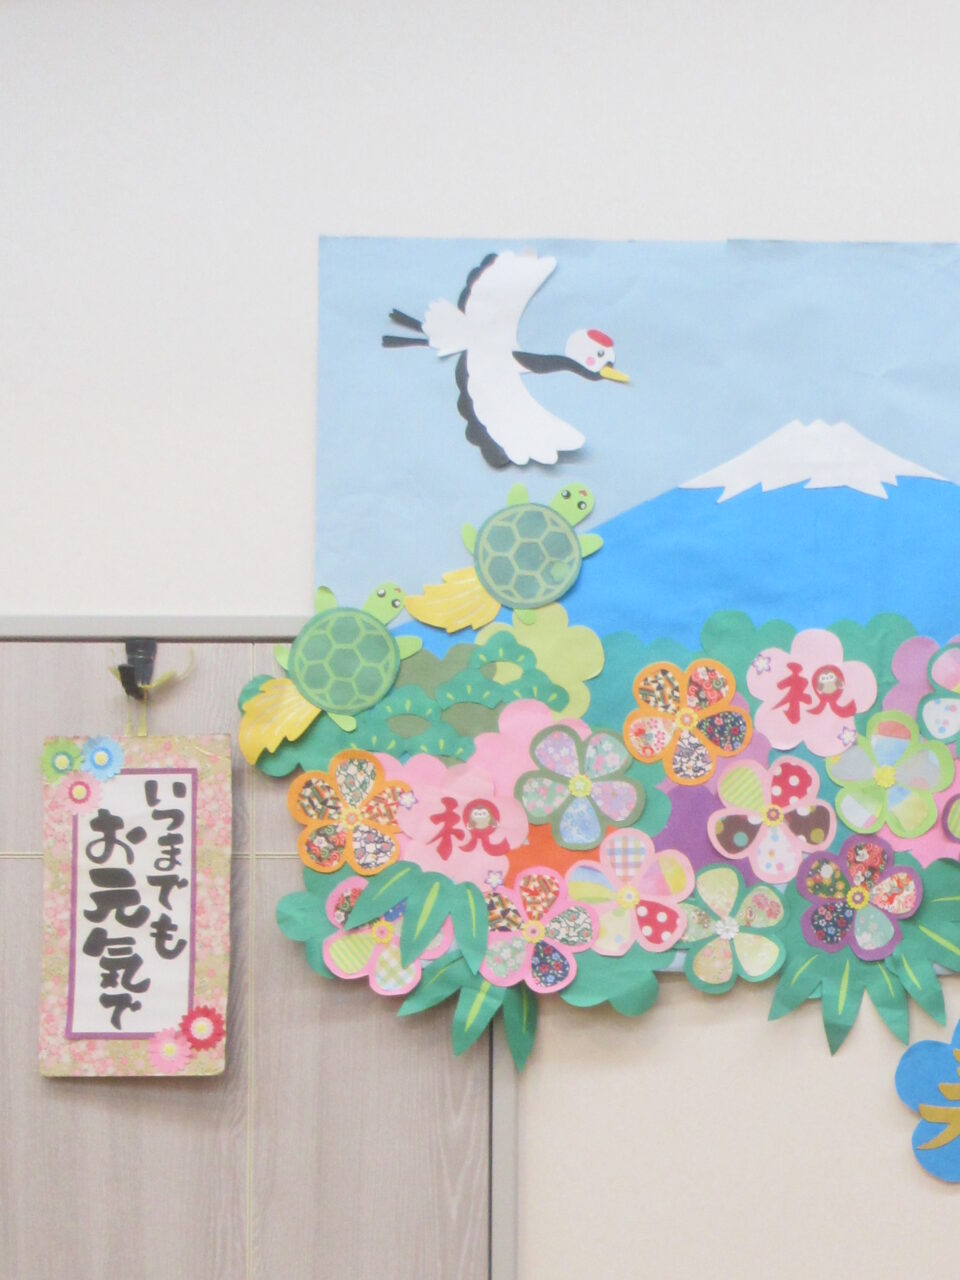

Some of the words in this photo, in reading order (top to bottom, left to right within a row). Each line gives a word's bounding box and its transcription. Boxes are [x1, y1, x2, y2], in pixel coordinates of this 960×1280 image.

[772, 662, 857, 724] 祝
[145, 780, 189, 960] いつまでも
[426, 797, 511, 860] 祝
[83, 808, 151, 1030] お元気で
